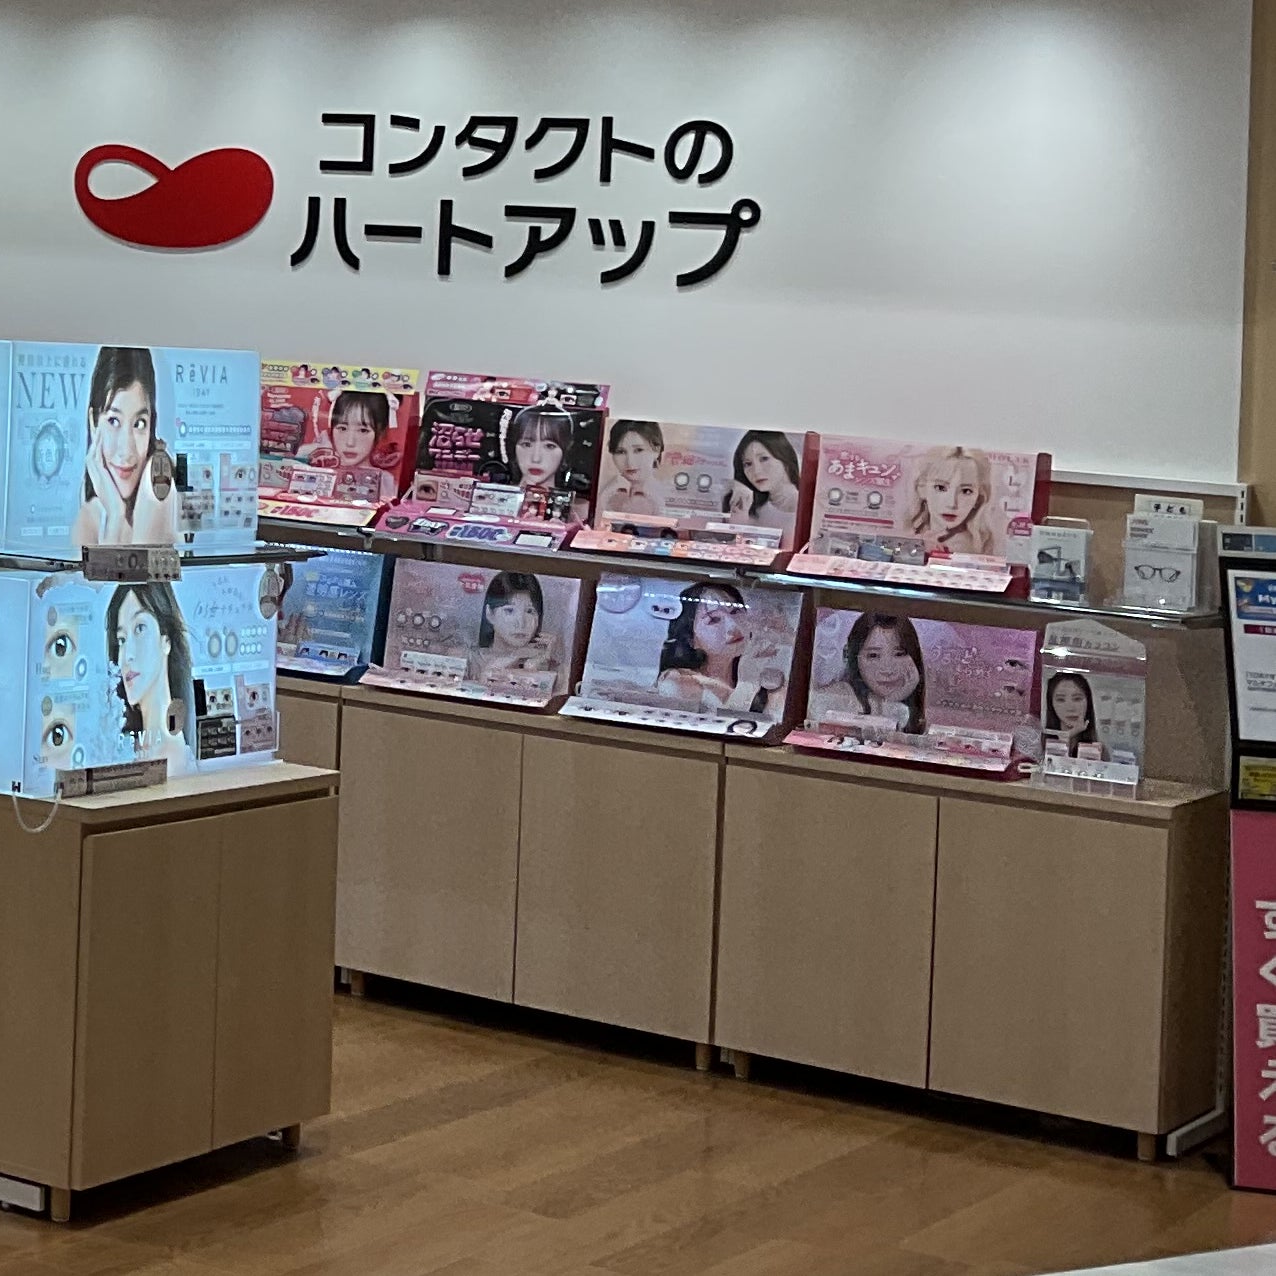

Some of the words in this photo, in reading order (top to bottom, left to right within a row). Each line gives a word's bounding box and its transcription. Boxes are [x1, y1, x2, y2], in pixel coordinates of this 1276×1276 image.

[319, 112, 734, 186] コンタクトの
[290, 196, 761, 288] ハートアップ
[16, 371, 86, 409] NEW
